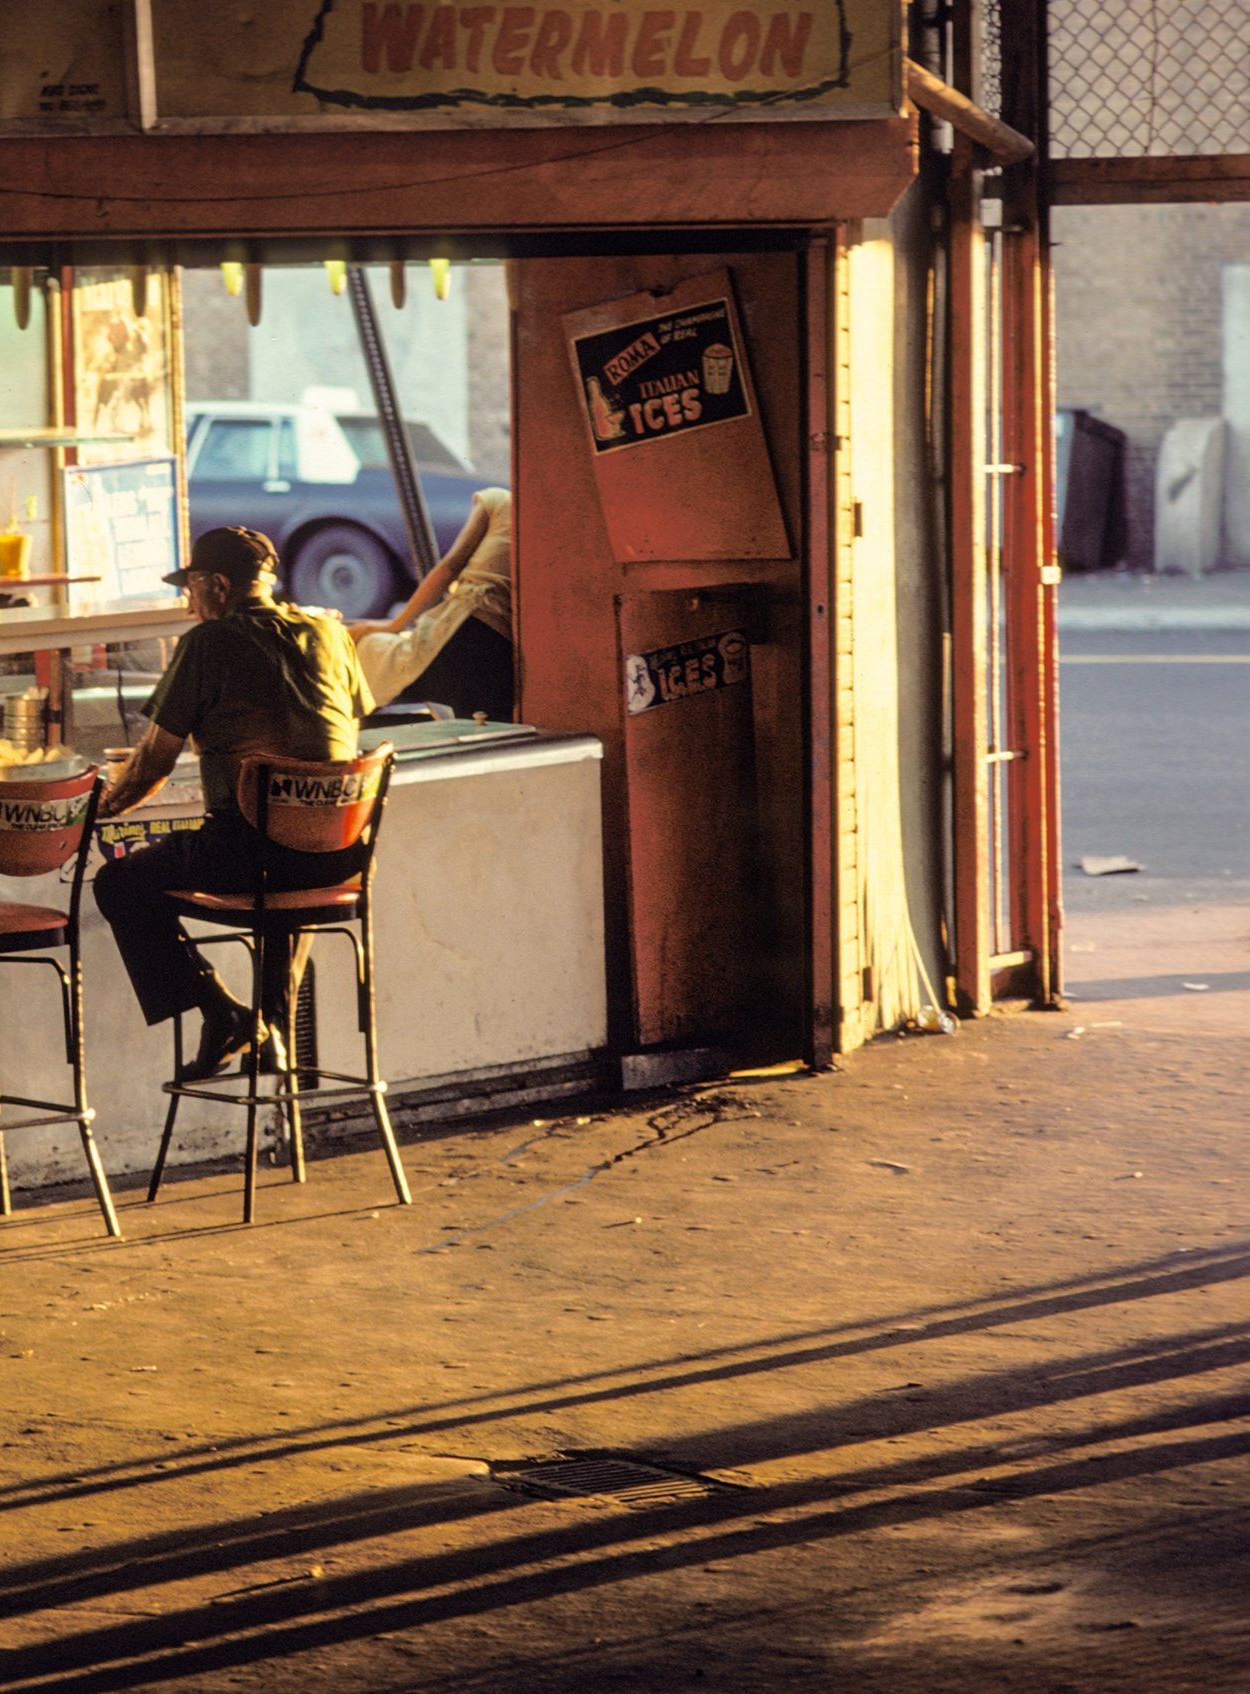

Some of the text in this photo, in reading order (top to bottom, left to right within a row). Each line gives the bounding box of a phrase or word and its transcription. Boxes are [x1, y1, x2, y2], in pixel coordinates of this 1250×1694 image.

[361, 2, 814, 81] WATERMELON
[606, 336, 656, 380] ROMA
[639, 369, 701, 399] ITALIAN
[628, 388, 703, 434] ICES
[658, 652, 718, 702] ICES
[295, 777, 357, 799] WNBC
[5, 803, 67, 823] WNBC
[150, 821, 171, 835] REAL
